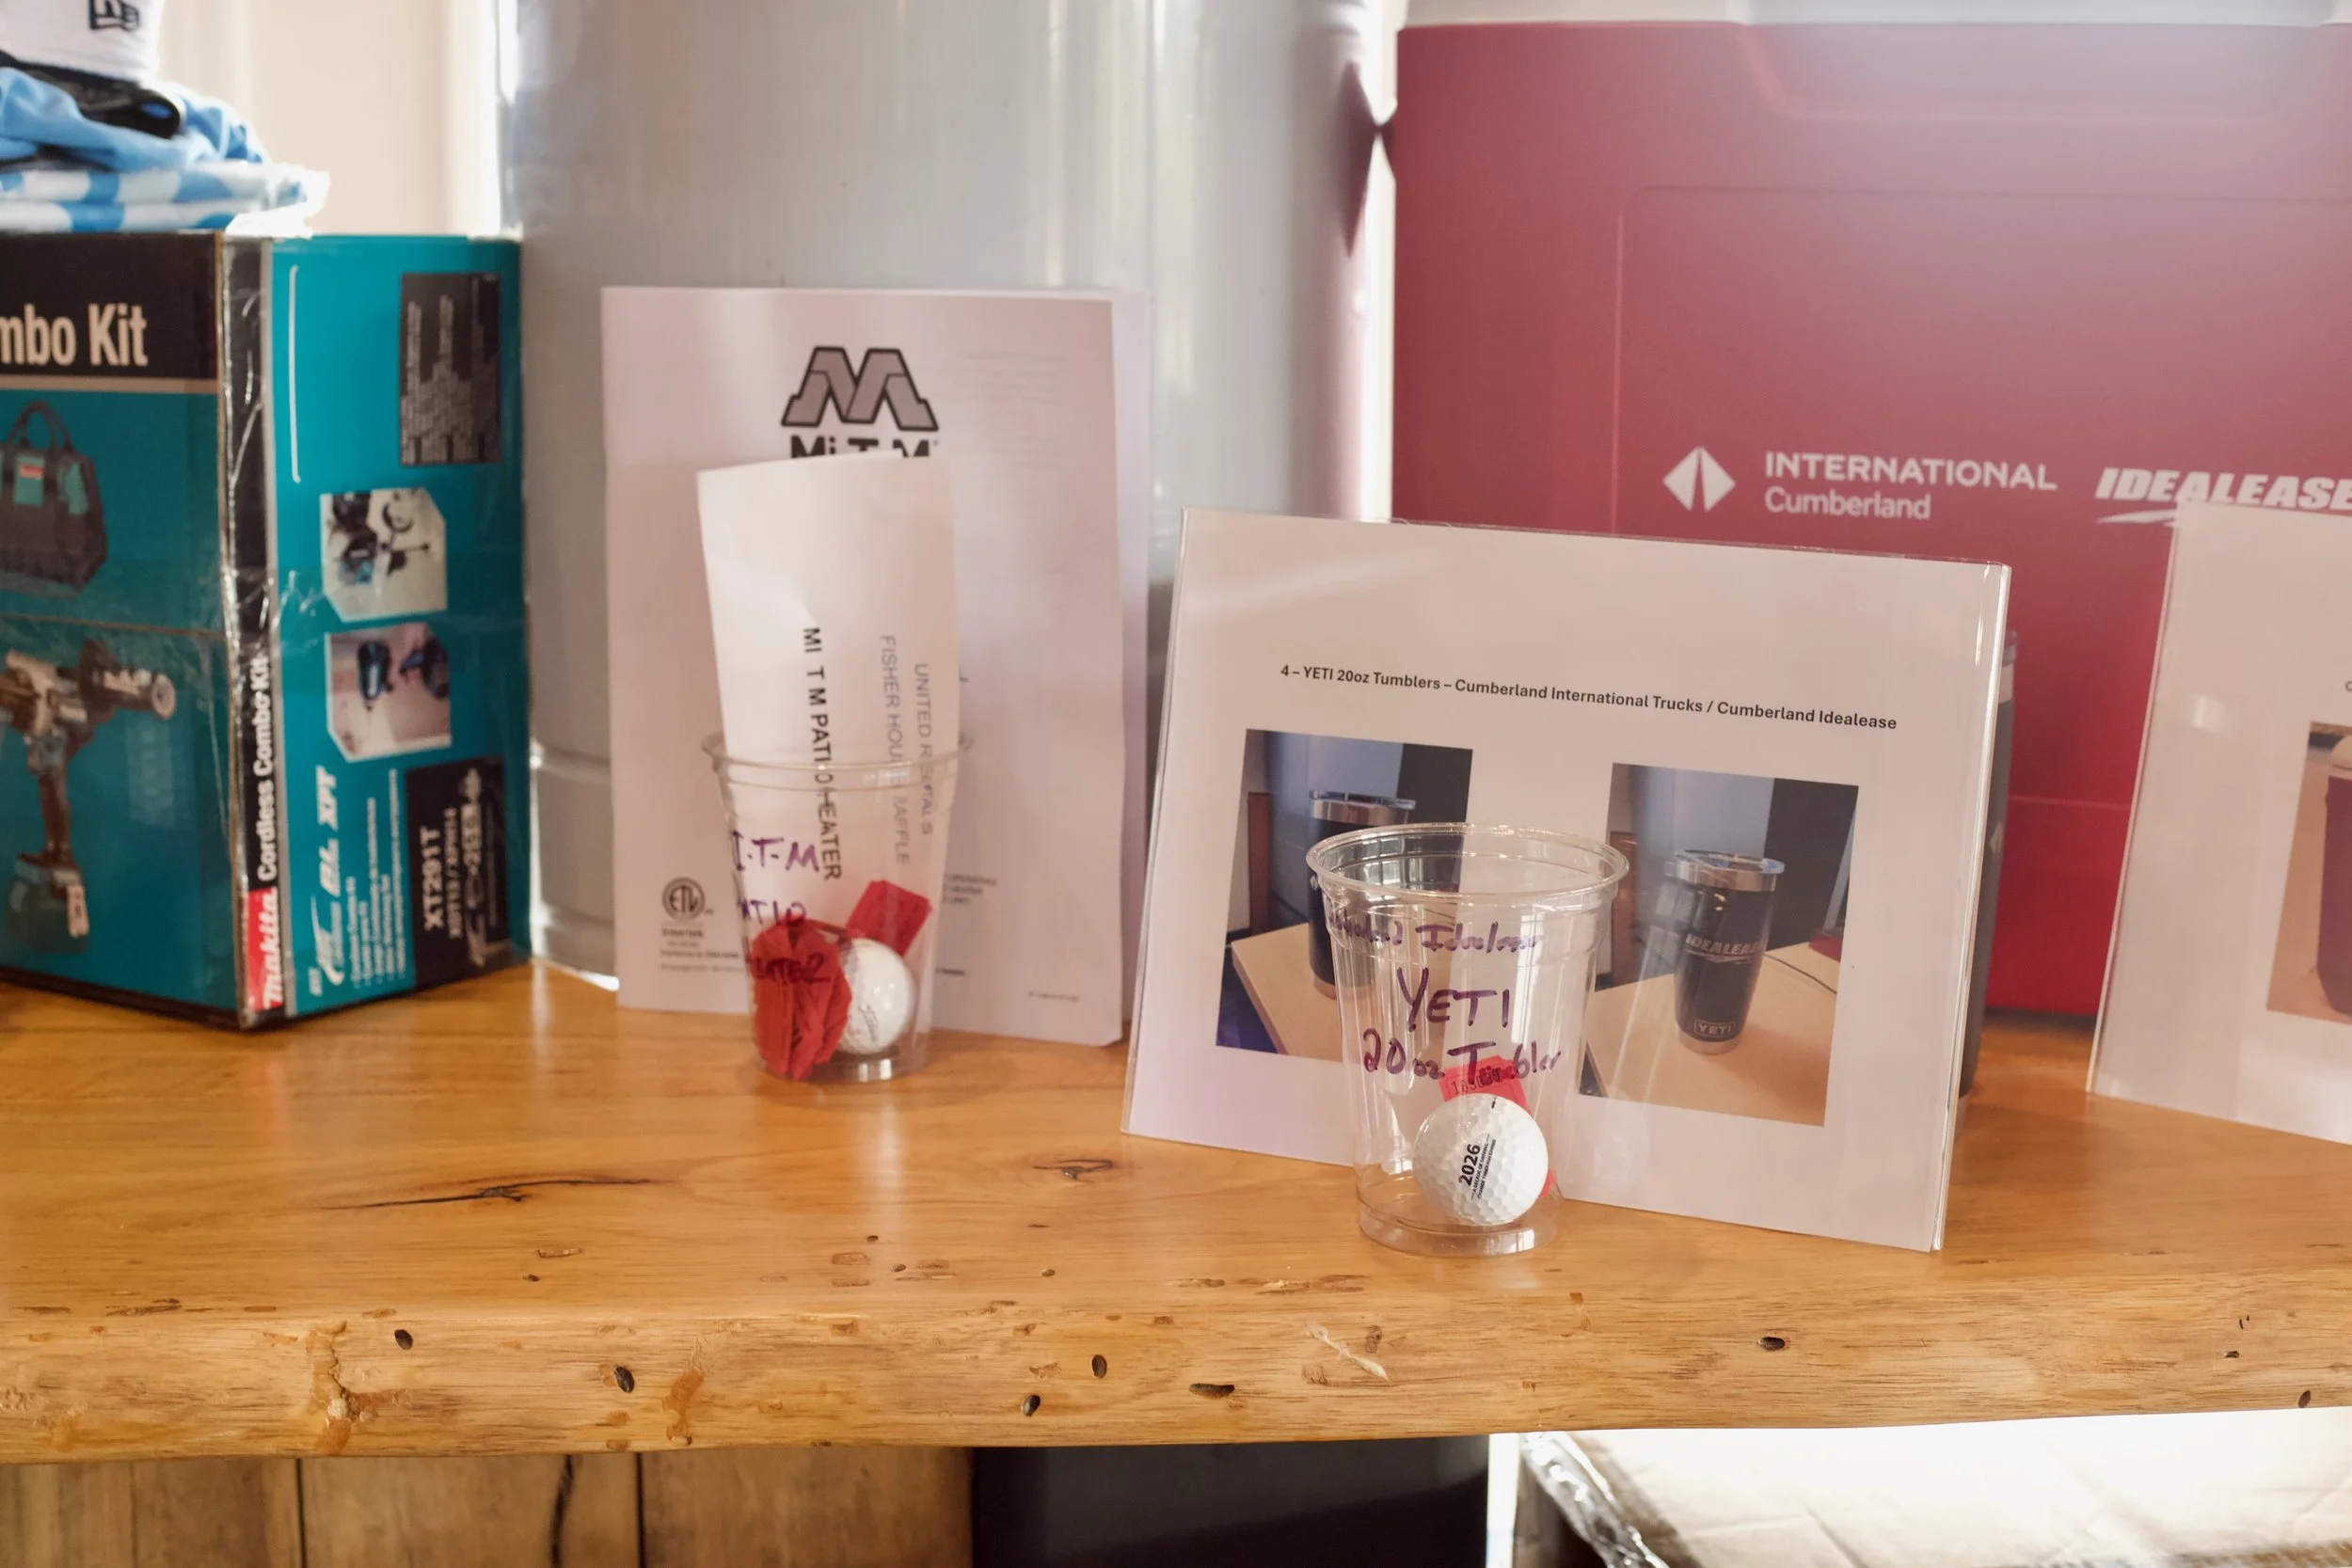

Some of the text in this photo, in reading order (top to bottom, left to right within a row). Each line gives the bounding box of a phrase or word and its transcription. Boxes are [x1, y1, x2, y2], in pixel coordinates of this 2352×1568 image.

[88, 303, 148, 366] Kit
[1764, 451, 2058, 491] INTERNATIONAL
[2095, 467, 2352, 511] IDEALEASE
[1764, 484, 1931, 520] Cumberland
[803, 627, 822, 654] MI
[806, 666, 824, 679] T
[809, 688, 827, 706] M
[881, 634, 900, 708] FISHER
[1280, 664, 1290, 676] 4
[1303, 665, 1333, 680] YETI
[1336, 669, 1370, 684] 20oz
[1373, 672, 1440, 689] Tumblers
[1454, 678, 1548, 699] Cumberland
[1551, 687, 1649, 708] International
[1652, 695, 1704, 713] Trucks
[1706, 700, 1714, 713] /
[1717, 700, 1816, 723] Cumberland
[1819, 710, 1898, 730] Idealease
[914, 662, 933, 737] UNITED
[252, 690, 273, 777] Combo
[810, 714, 834, 784] PATIO
[257, 779, 278, 882] Cordless
[1396, 966, 1512, 1034] YETI
[1696, 1022, 1732, 1036] YETI
[1458, 1143, 1482, 1186] 2026
